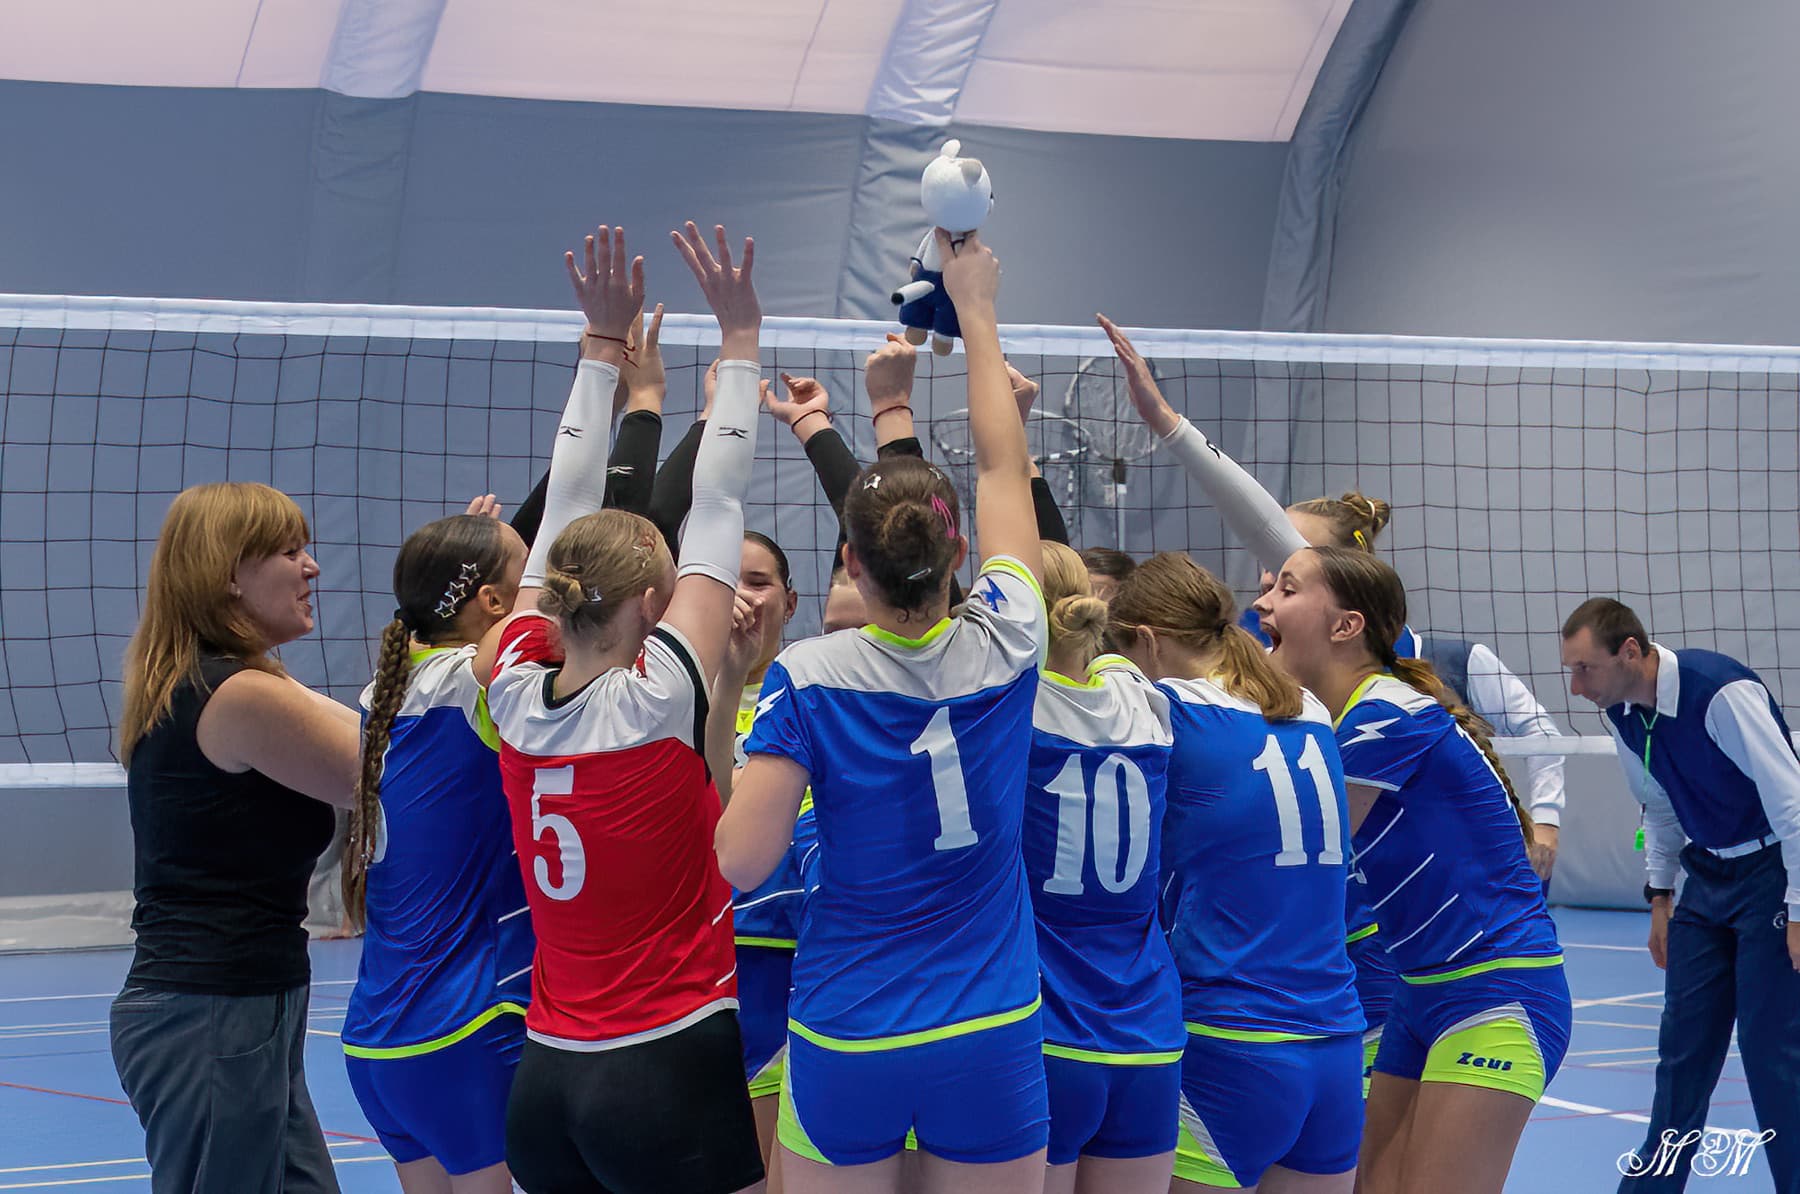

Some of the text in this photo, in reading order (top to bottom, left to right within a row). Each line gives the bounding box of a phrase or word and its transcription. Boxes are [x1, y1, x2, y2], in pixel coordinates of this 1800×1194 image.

[531, 765, 586, 901] 5
[910, 706, 979, 851] 1
[1043, 753, 1151, 895] 10
[1252, 733, 1343, 866] 11
[1456, 1052, 1513, 1071] Zeus
